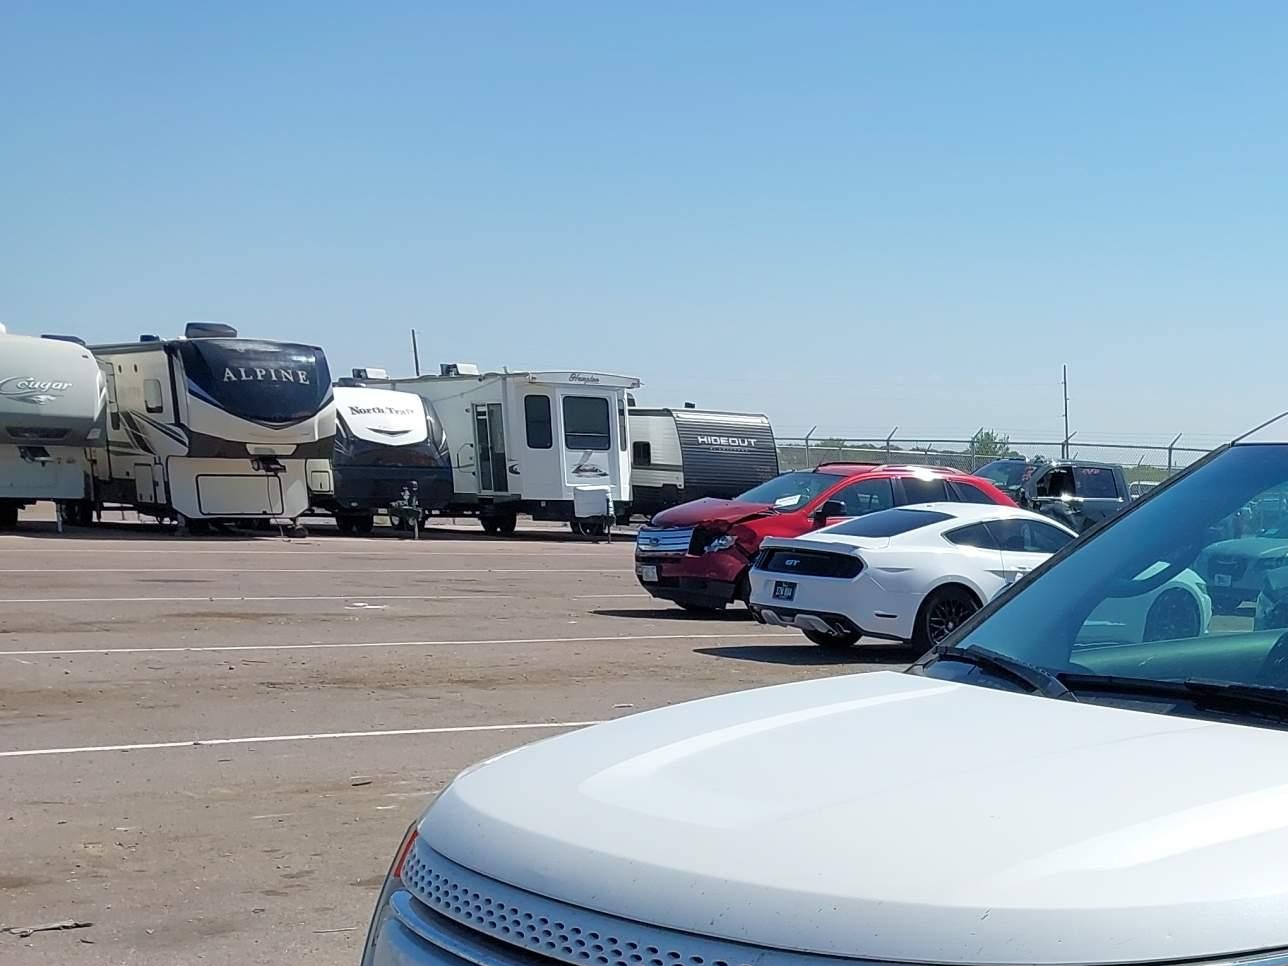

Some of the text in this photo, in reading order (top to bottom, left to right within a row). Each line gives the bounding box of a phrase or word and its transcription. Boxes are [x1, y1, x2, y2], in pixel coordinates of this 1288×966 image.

[224, 367, 310, 385] ALPINE
[0, 376, 73, 395] Cougar
[348, 406, 385, 415] North
[697, 435, 757, 447] HIDEOUT
